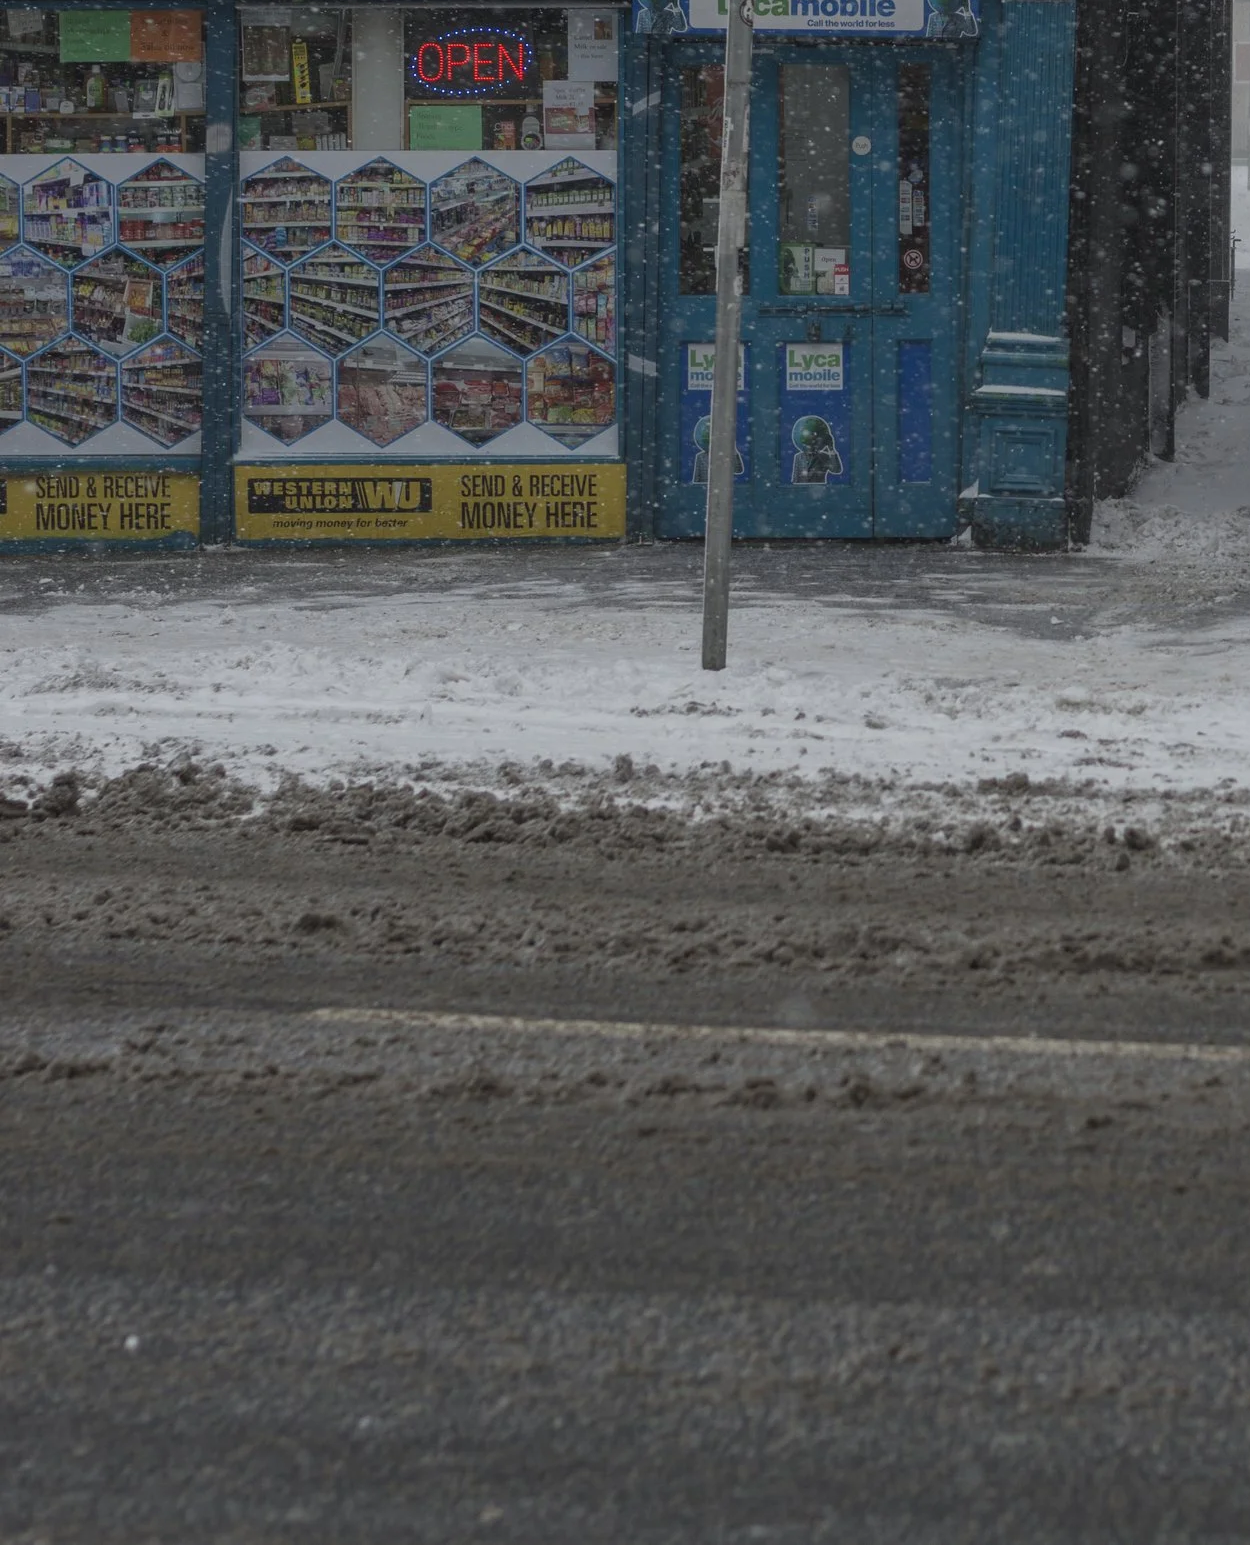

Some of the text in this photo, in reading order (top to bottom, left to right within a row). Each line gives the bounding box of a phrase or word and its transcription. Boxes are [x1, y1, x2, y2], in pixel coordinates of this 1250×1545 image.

[807, 19, 895, 27] Call the world for less
[417, 42, 524, 82] OPEN
[821, 256, 837, 264] Open
[690, 349, 742, 371] Ly
[789, 350, 840, 371] Lyca
[690, 369, 742, 381] moe
[789, 369, 840, 381] mobile
[36, 475, 171, 499] SEND & RECEIVE
[253, 481, 352, 495] WESTERN
[362, 481, 421, 510] WU
[461, 474, 597, 498] SEND & RECEIVE
[285, 495, 352, 509] UNION
[36, 503, 171, 530] MONEY HERE
[272, 518, 408, 530] moving money for better
[461, 501, 597, 530] MONEY HERE
